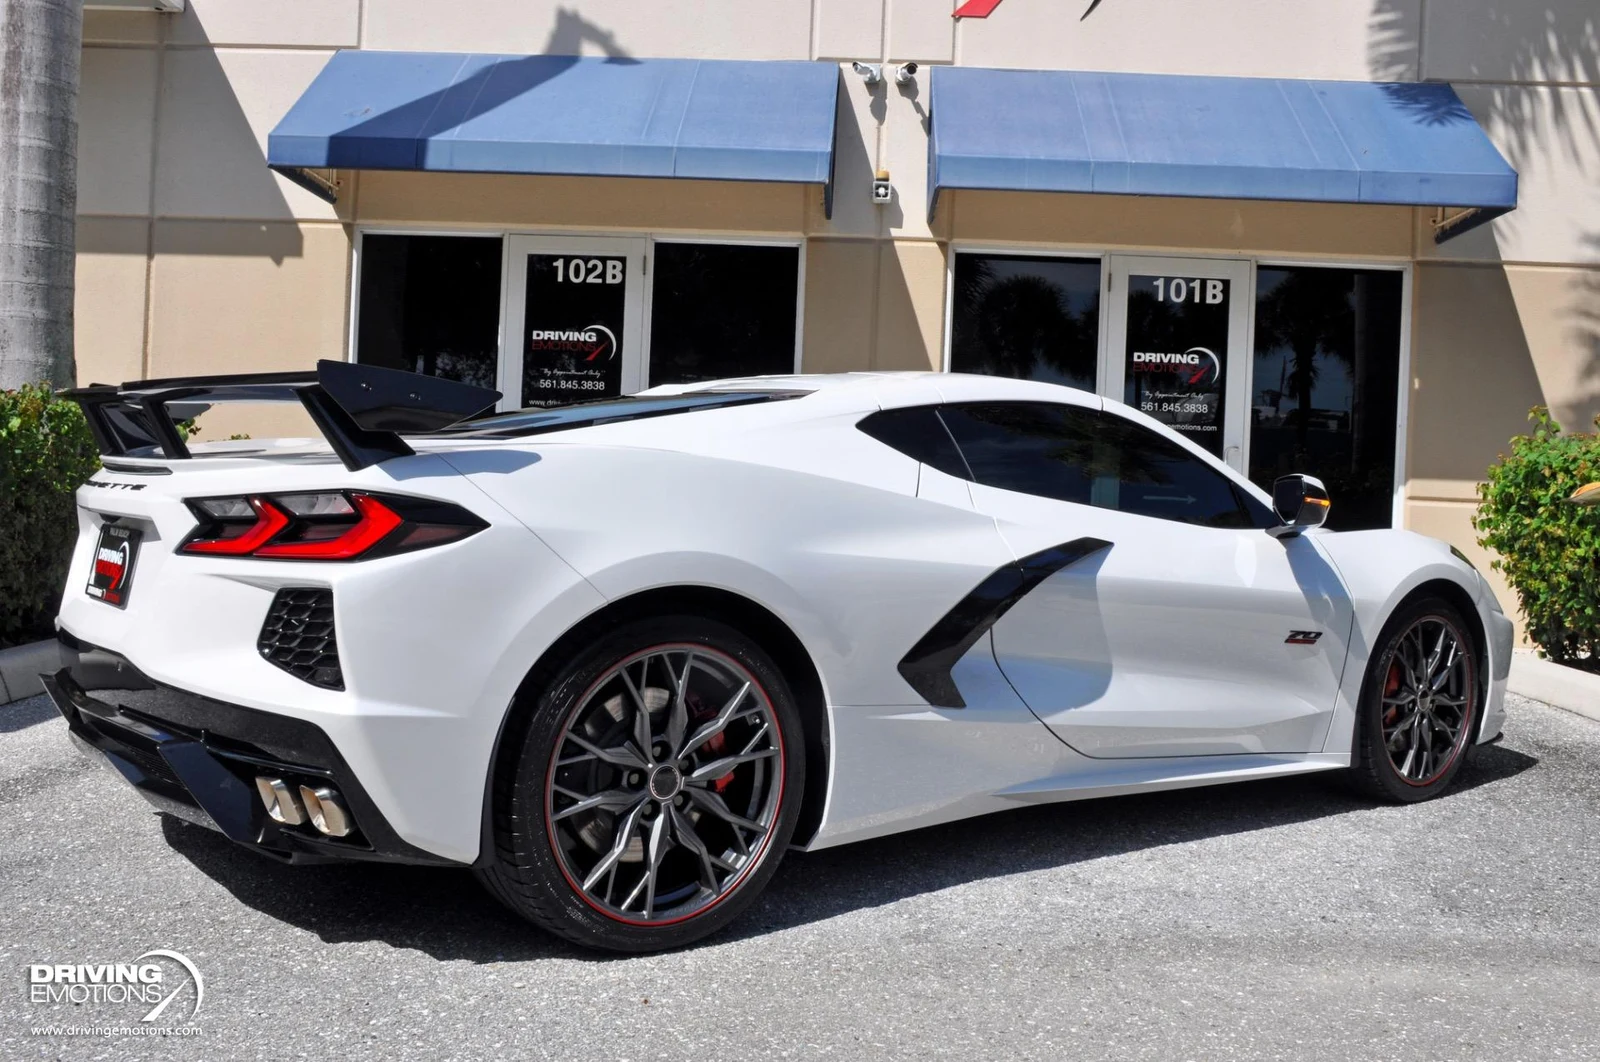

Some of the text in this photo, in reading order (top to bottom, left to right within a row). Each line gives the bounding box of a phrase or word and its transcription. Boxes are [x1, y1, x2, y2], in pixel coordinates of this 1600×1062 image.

[553, 258, 623, 284] 102B
[1153, 278, 1223, 304] 101B
[532, 330, 597, 342] DRIVING
[532, 341, 597, 351] EMOTIONS
[1133, 352, 1200, 364] DRIVING
[539, 379, 605, 391] 561.845.3838
[1141, 402, 1208, 413] 561.845.3838
